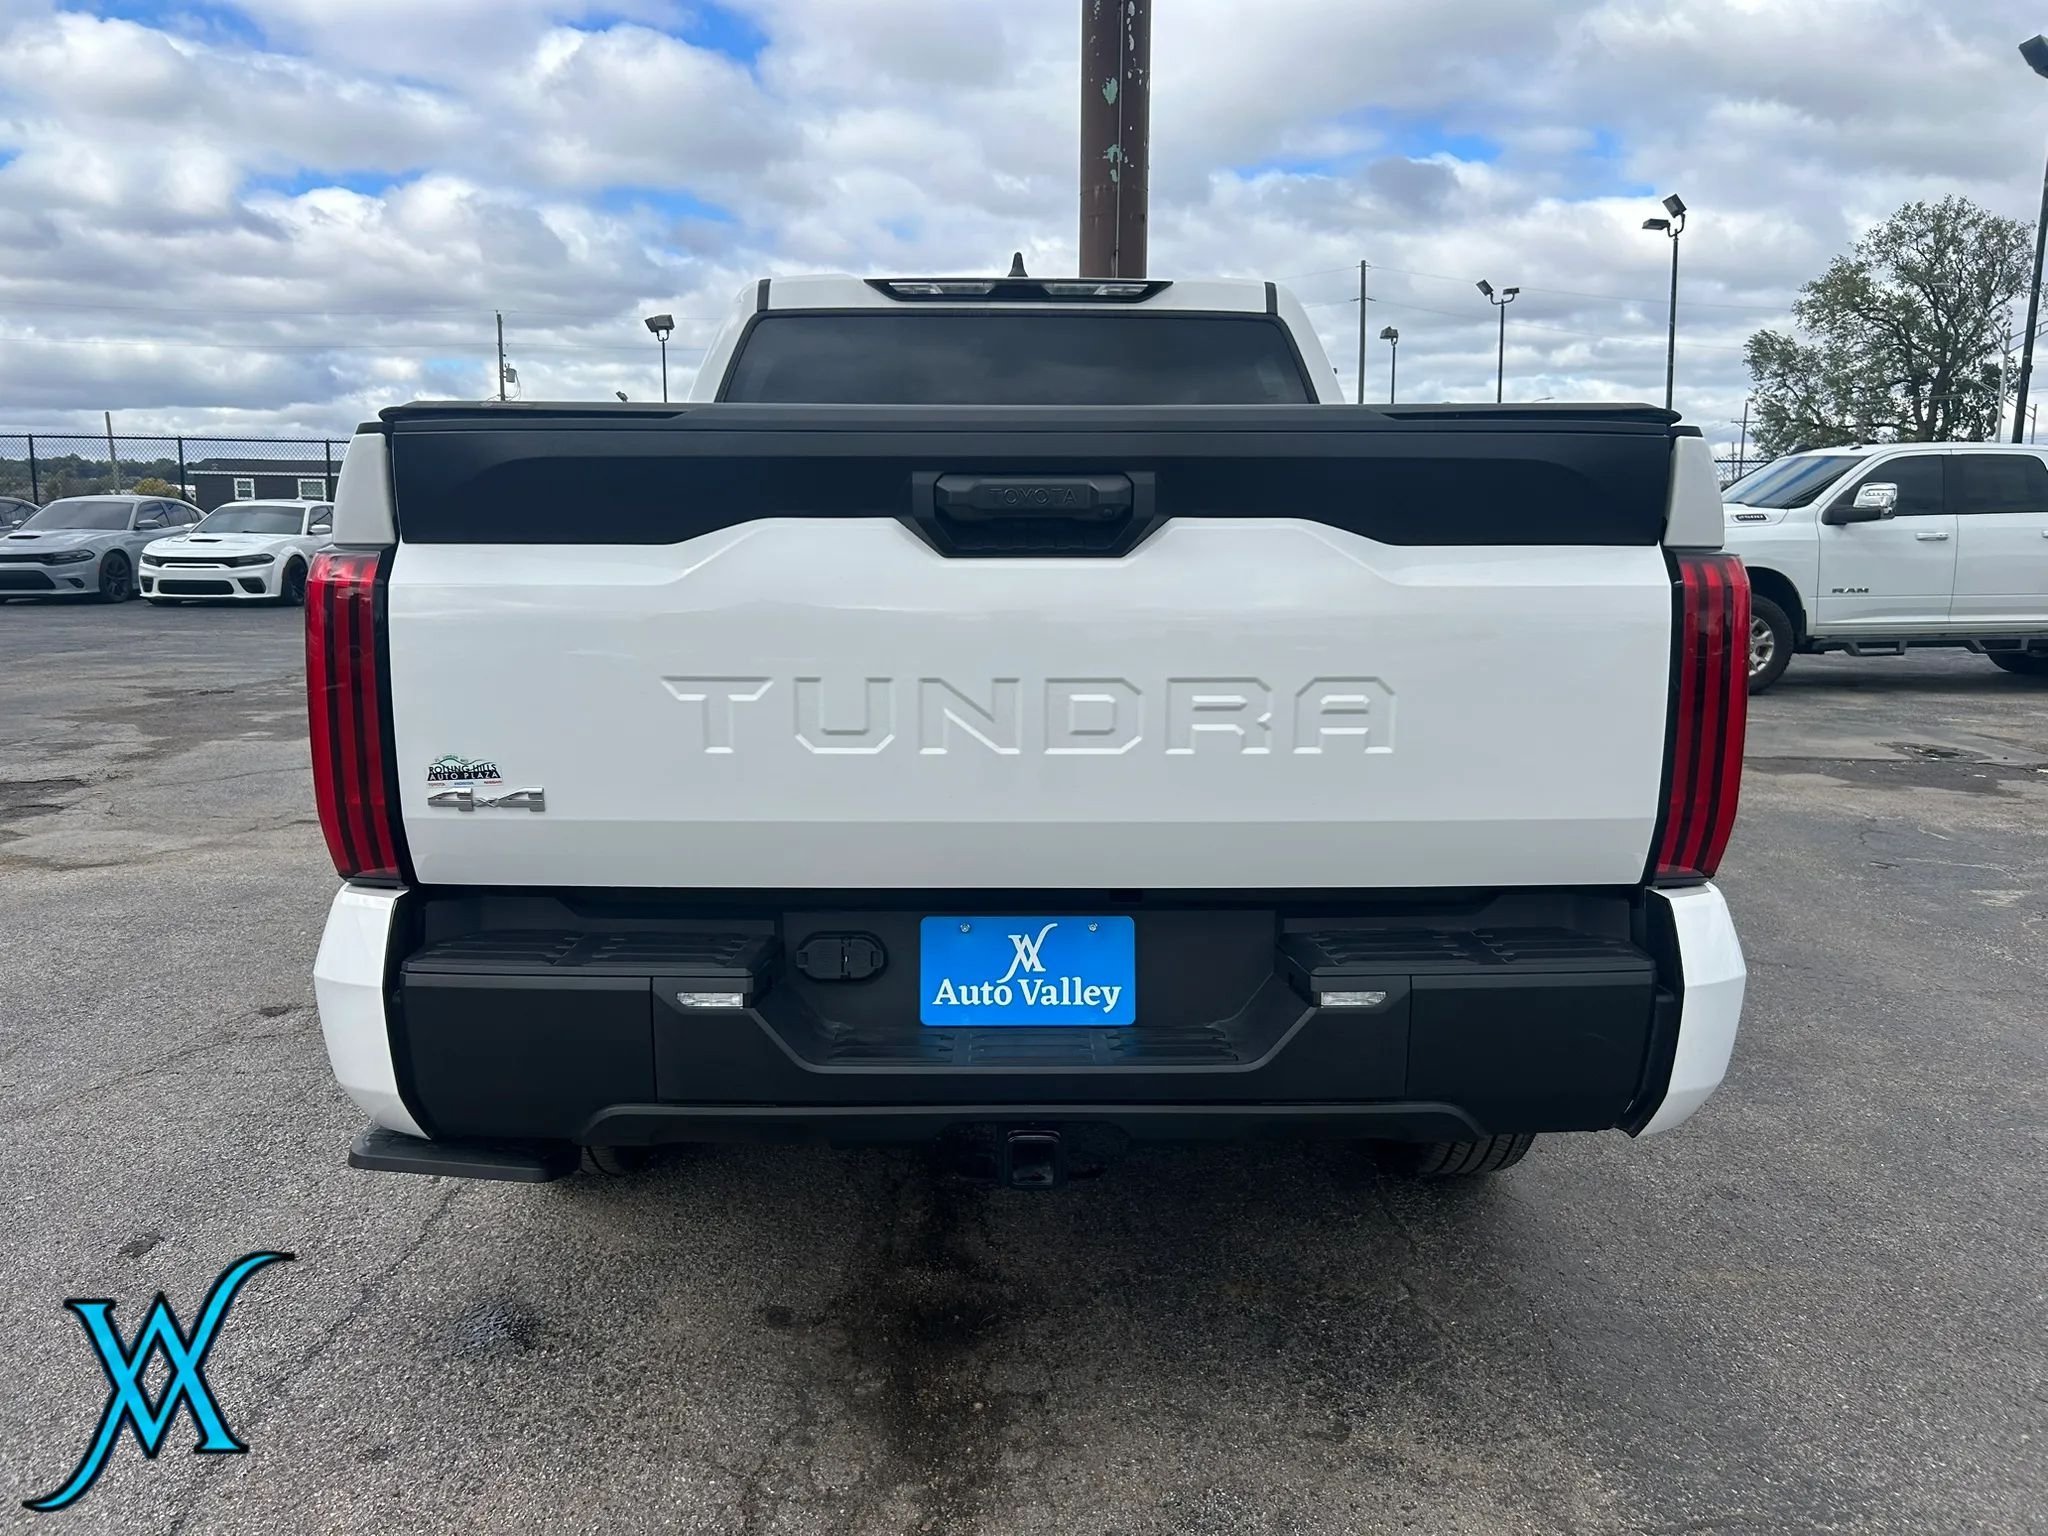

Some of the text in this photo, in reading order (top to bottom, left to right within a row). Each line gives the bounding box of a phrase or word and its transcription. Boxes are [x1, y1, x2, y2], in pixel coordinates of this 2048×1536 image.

[987, 487, 1078, 505] TOYOTA
[660, 675, 1396, 755] TUNDRA
[429, 771, 499, 781] AUTO PLAZA
[472, 763, 497, 773] HILLS
[932, 976, 1123, 1014] Auto Valley
